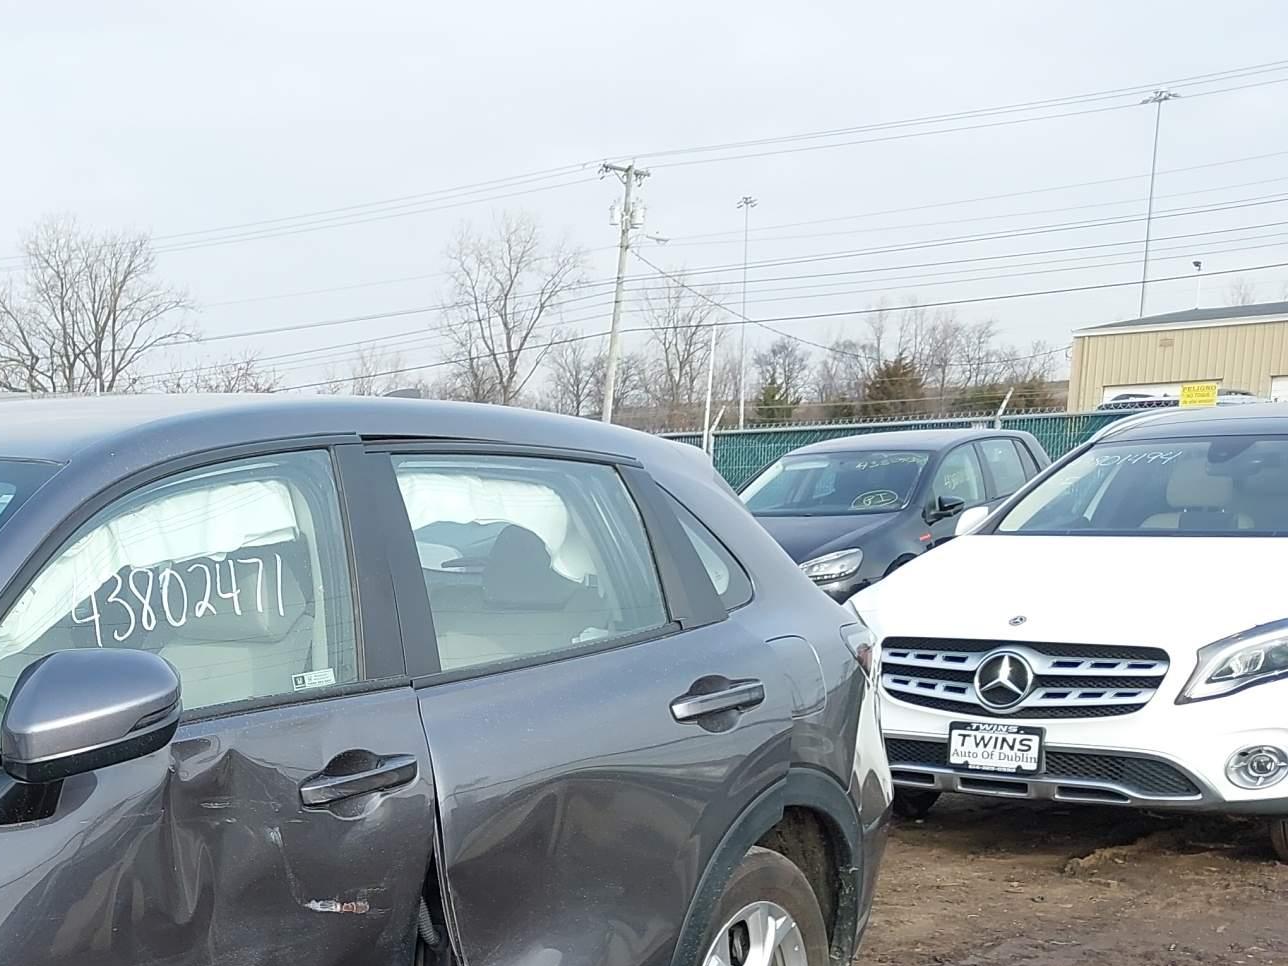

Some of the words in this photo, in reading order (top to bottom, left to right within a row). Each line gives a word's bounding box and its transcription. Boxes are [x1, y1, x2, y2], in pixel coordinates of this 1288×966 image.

[71, 553, 286, 647] 43802471
[970, 723, 1019, 732] TWINS
[957, 733, 1033, 753] TWINS
[952, 748, 978, 758] Auto
[981, 750, 995, 760] Of
[998, 752, 1037, 764] Dublin
